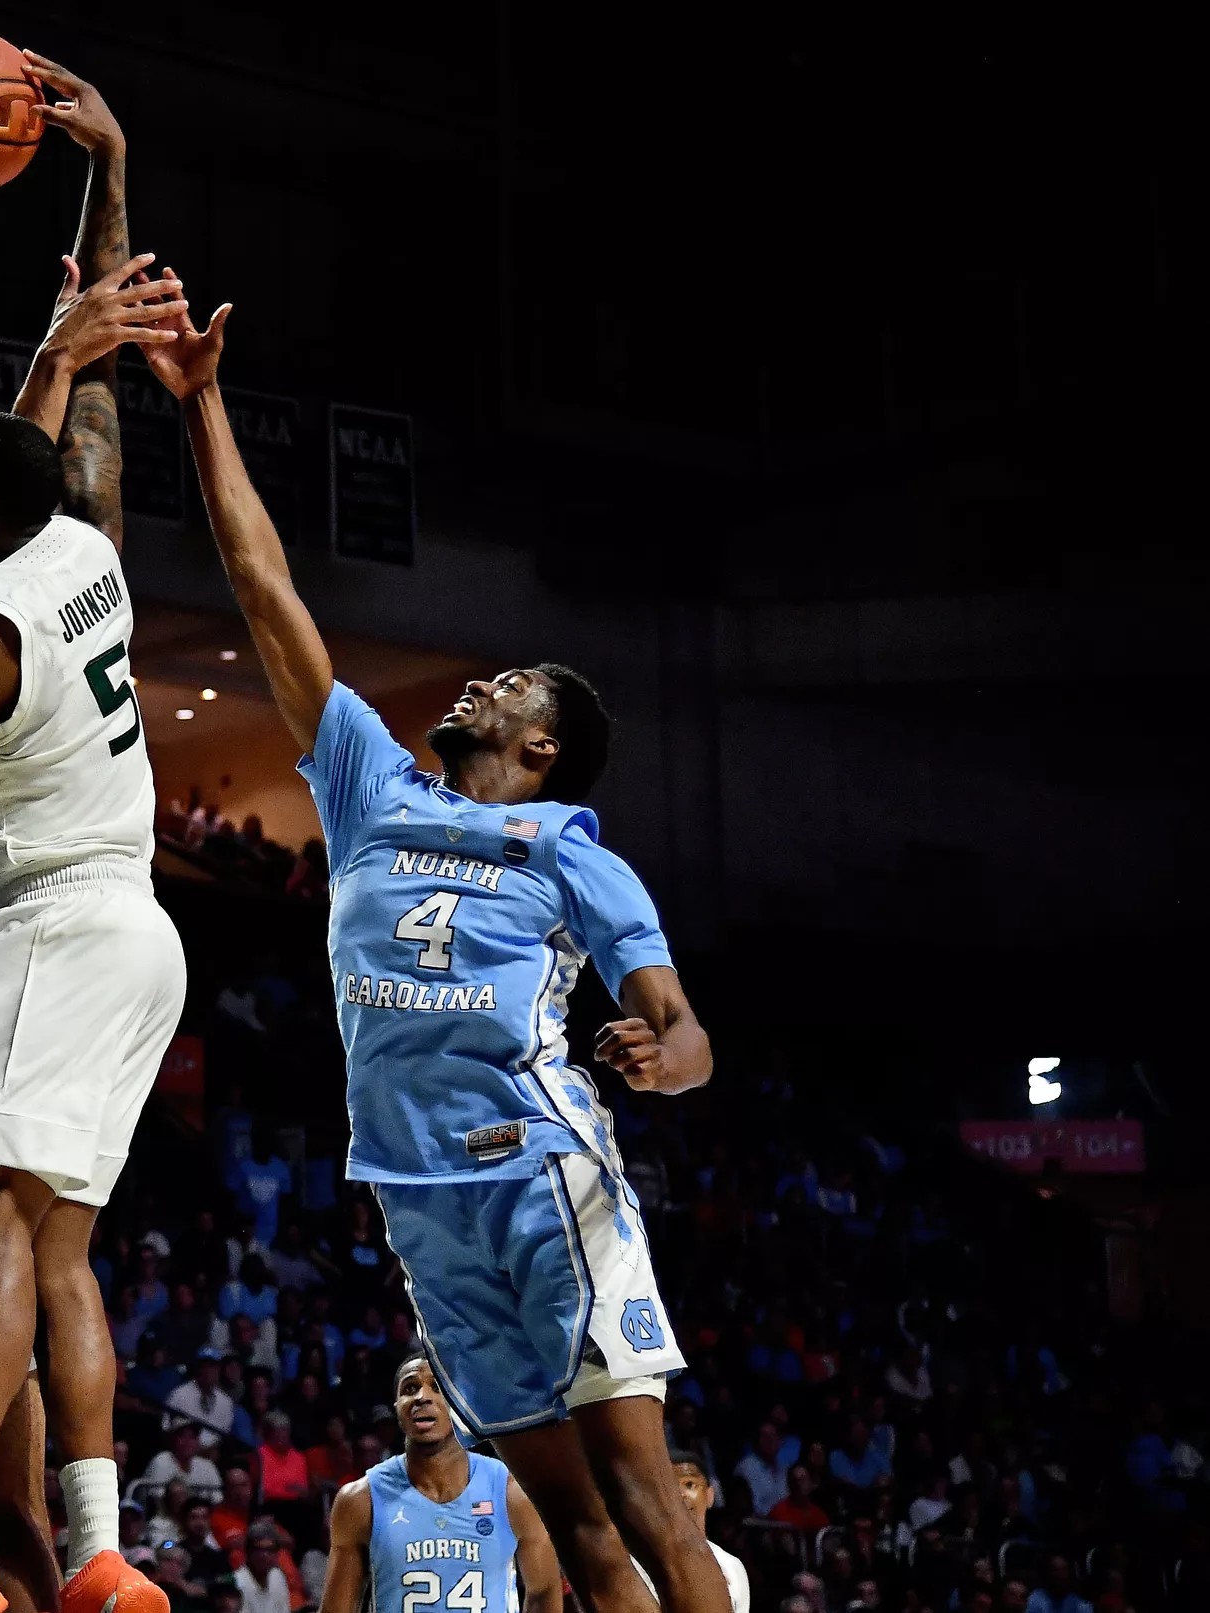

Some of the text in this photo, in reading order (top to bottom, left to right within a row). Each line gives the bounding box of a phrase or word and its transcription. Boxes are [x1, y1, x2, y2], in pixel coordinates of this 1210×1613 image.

[339, 427, 407, 466] NCAA
[58, 568, 124, 644] JOHNSON
[83, 639, 141, 758] 5
[389, 850, 505, 892] NORTH
[394, 889, 463, 972] 4
[345, 973, 497, 1012] CAROLINA
[405, 1537, 481, 1564] NORTH
[401, 1569, 487, 1613] 24
